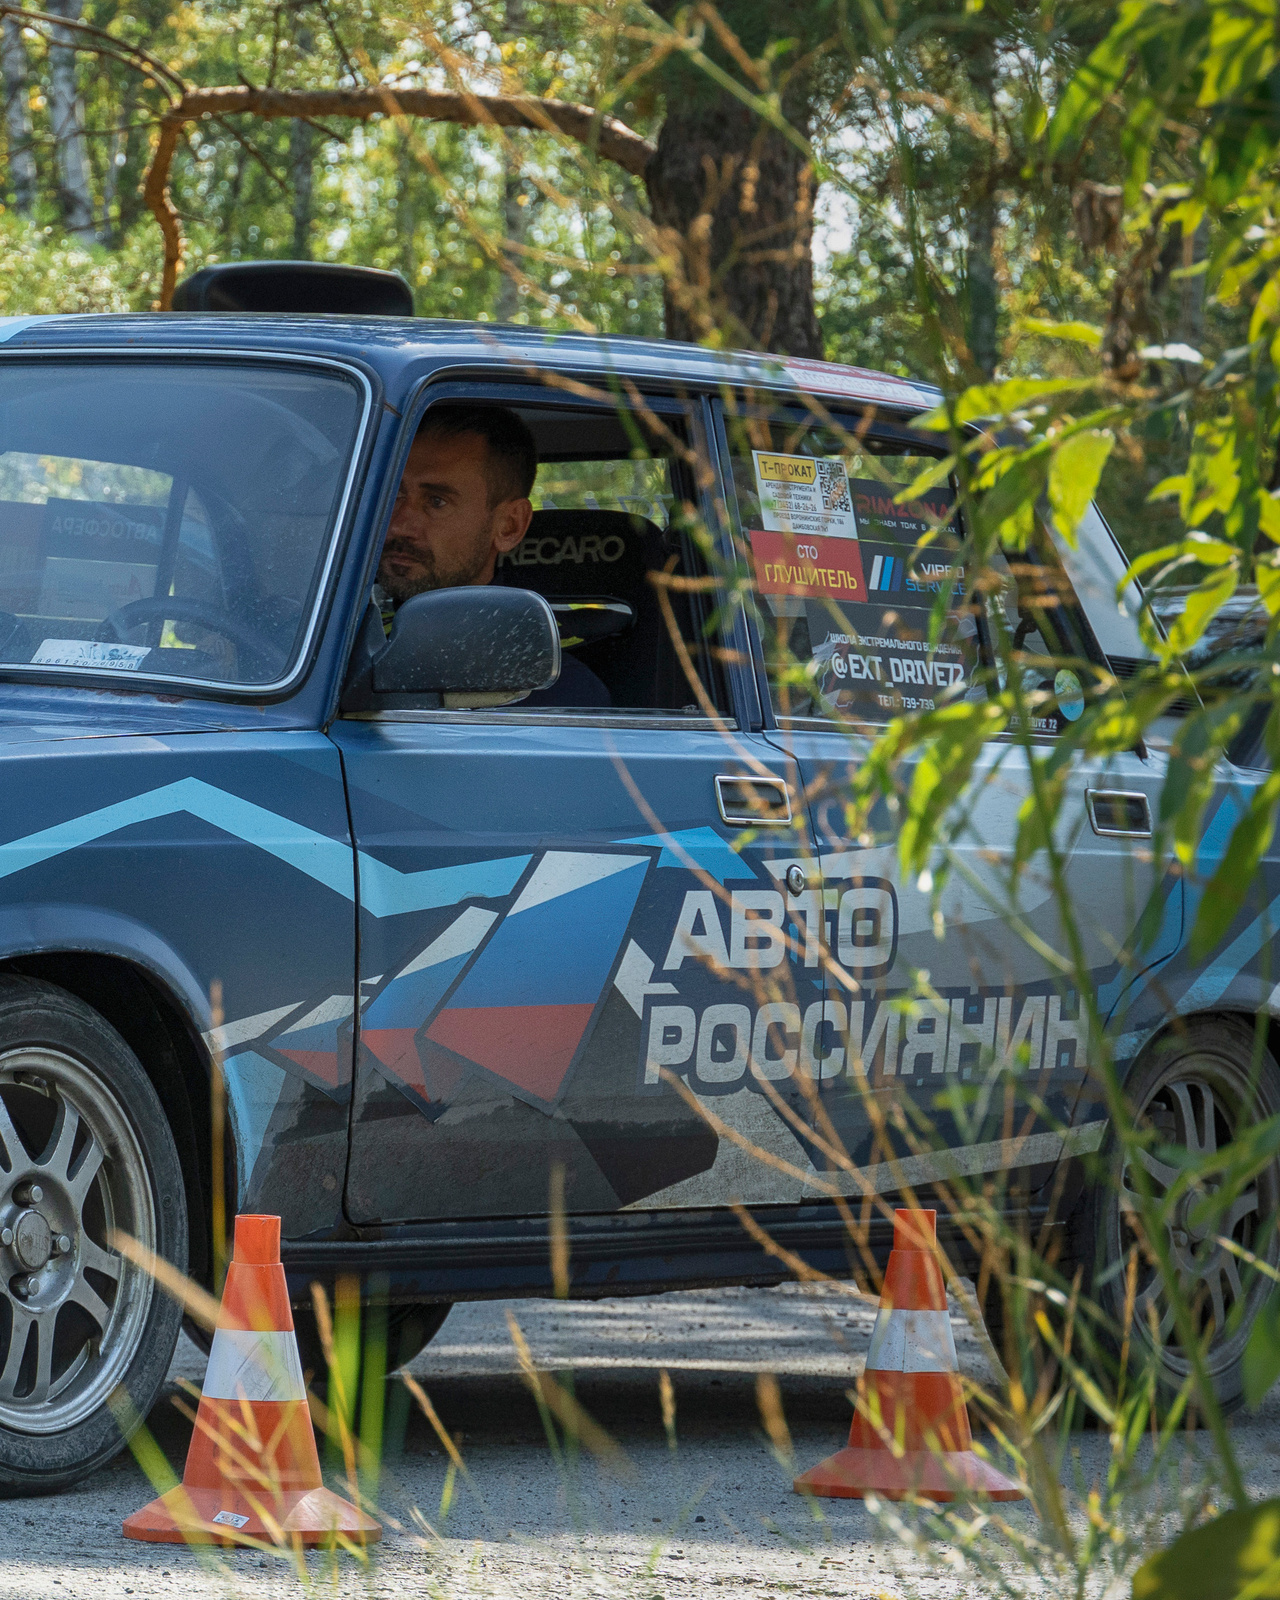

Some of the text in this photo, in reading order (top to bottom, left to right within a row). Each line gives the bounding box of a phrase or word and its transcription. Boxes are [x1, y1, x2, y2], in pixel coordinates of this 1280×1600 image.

[761, 460, 813, 478] Т-ПРОКАТ
[782, 483, 813, 492] СТРУМЕНТА
[900, 521, 918, 530] ТОЛК
[797, 544, 818, 560] СТО
[764, 563, 858, 590] ГЛУШИТЕЛЬ
[905, 578, 967, 596] SERVCE
[830, 632, 857, 645] ШКОЛА
[857, 635, 922, 651] ЭКСТРЕМАЛЬНОГО
[901, 697, 935, 710] 739-739
[662, 888, 894, 970] АВТО
[644, 993, 1091, 1085] РОССИЯНИН
